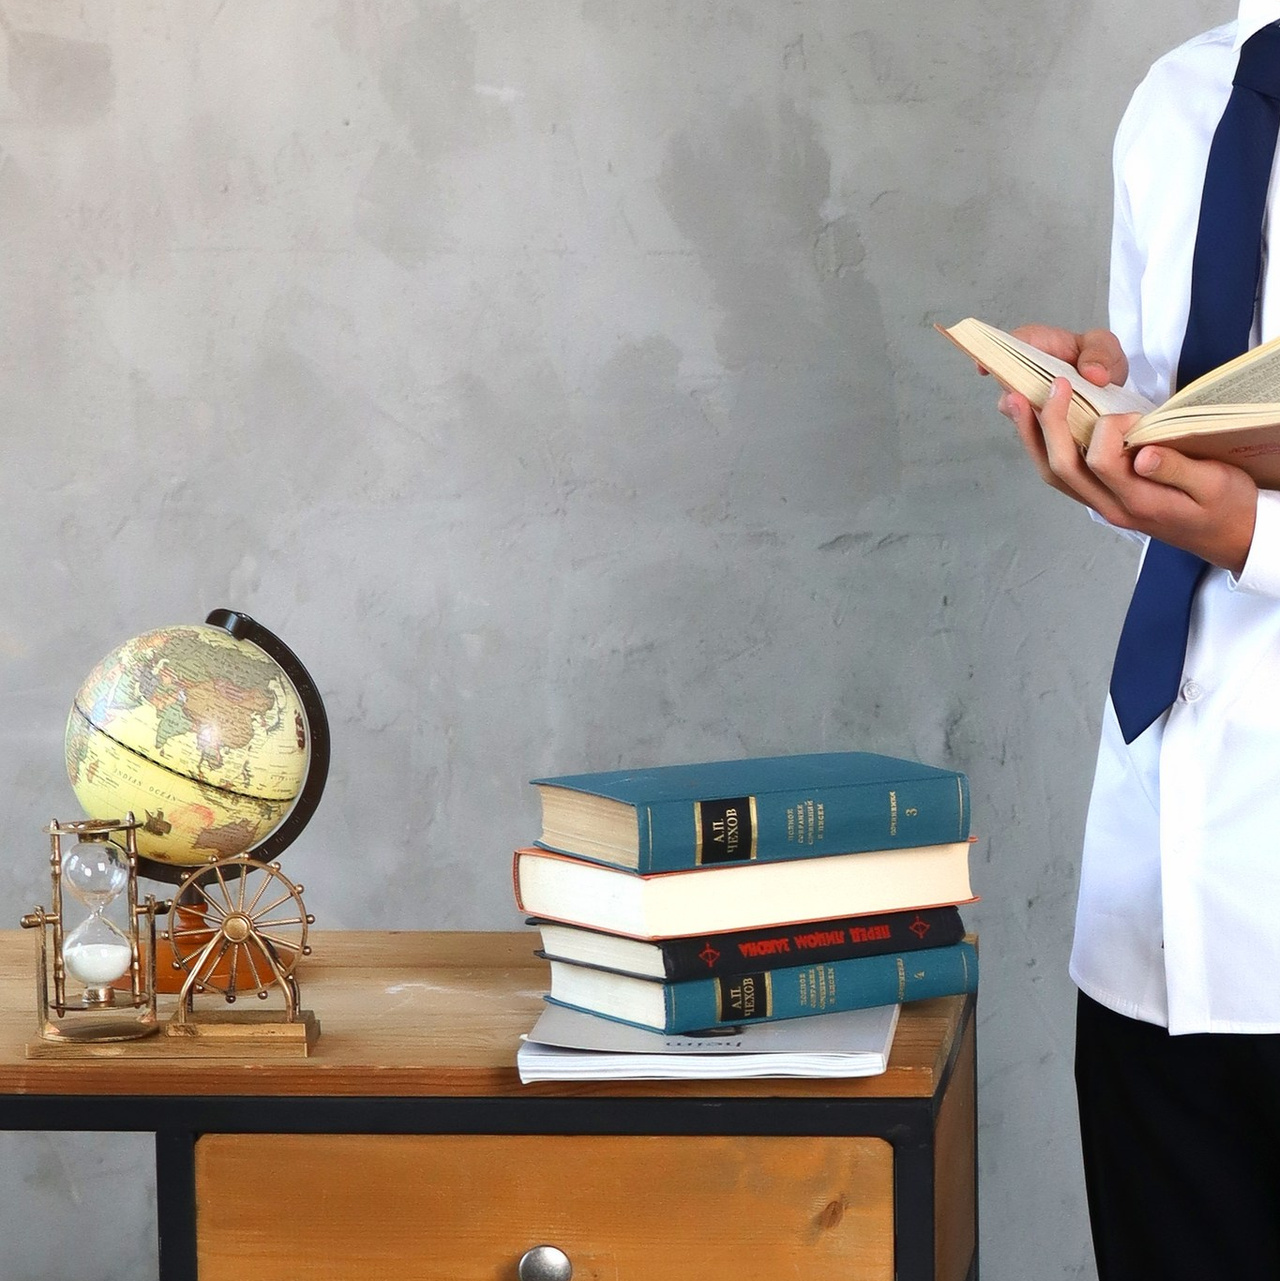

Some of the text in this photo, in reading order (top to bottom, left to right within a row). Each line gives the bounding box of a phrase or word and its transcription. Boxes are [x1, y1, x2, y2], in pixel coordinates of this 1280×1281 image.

[726, 808, 739, 853] ЧЕХОВ
[905, 808, 918, 817] 3
[738, 925, 891, 958] ПЕРЕД ЛИЦОМ ЗАКОНА
[743, 978, 756, 1017] ЧЕХОВ
